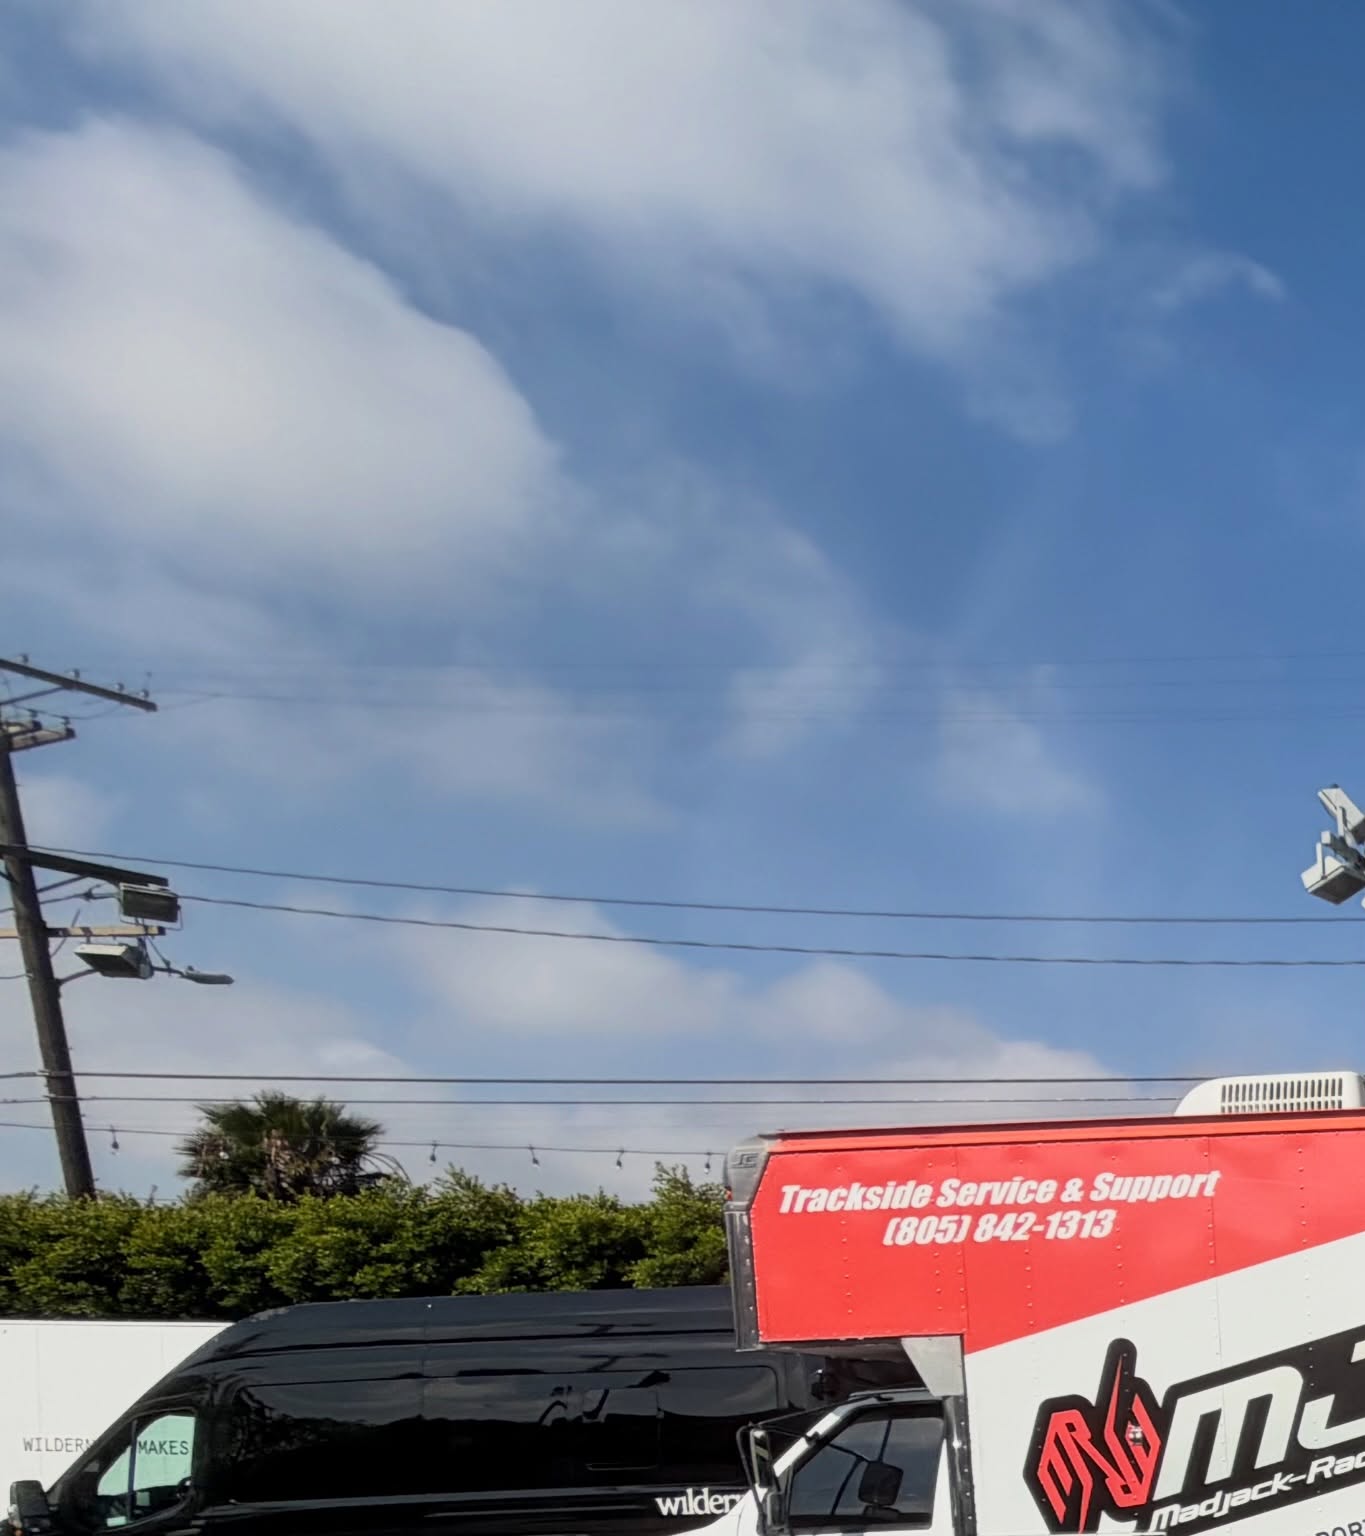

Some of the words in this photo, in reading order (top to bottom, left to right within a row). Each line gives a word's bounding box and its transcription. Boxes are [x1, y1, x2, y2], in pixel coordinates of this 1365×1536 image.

[779, 1180, 933, 1213] Trackside
[937, 1176, 1058, 1207] Service
[1060, 1178, 1083, 1202] &
[1089, 1170, 1221, 1201] Support
[883, 1214, 968, 1246] (805)
[974, 1209, 1116, 1242] 842-1313
[138, 1440, 190, 1455] MAKES
